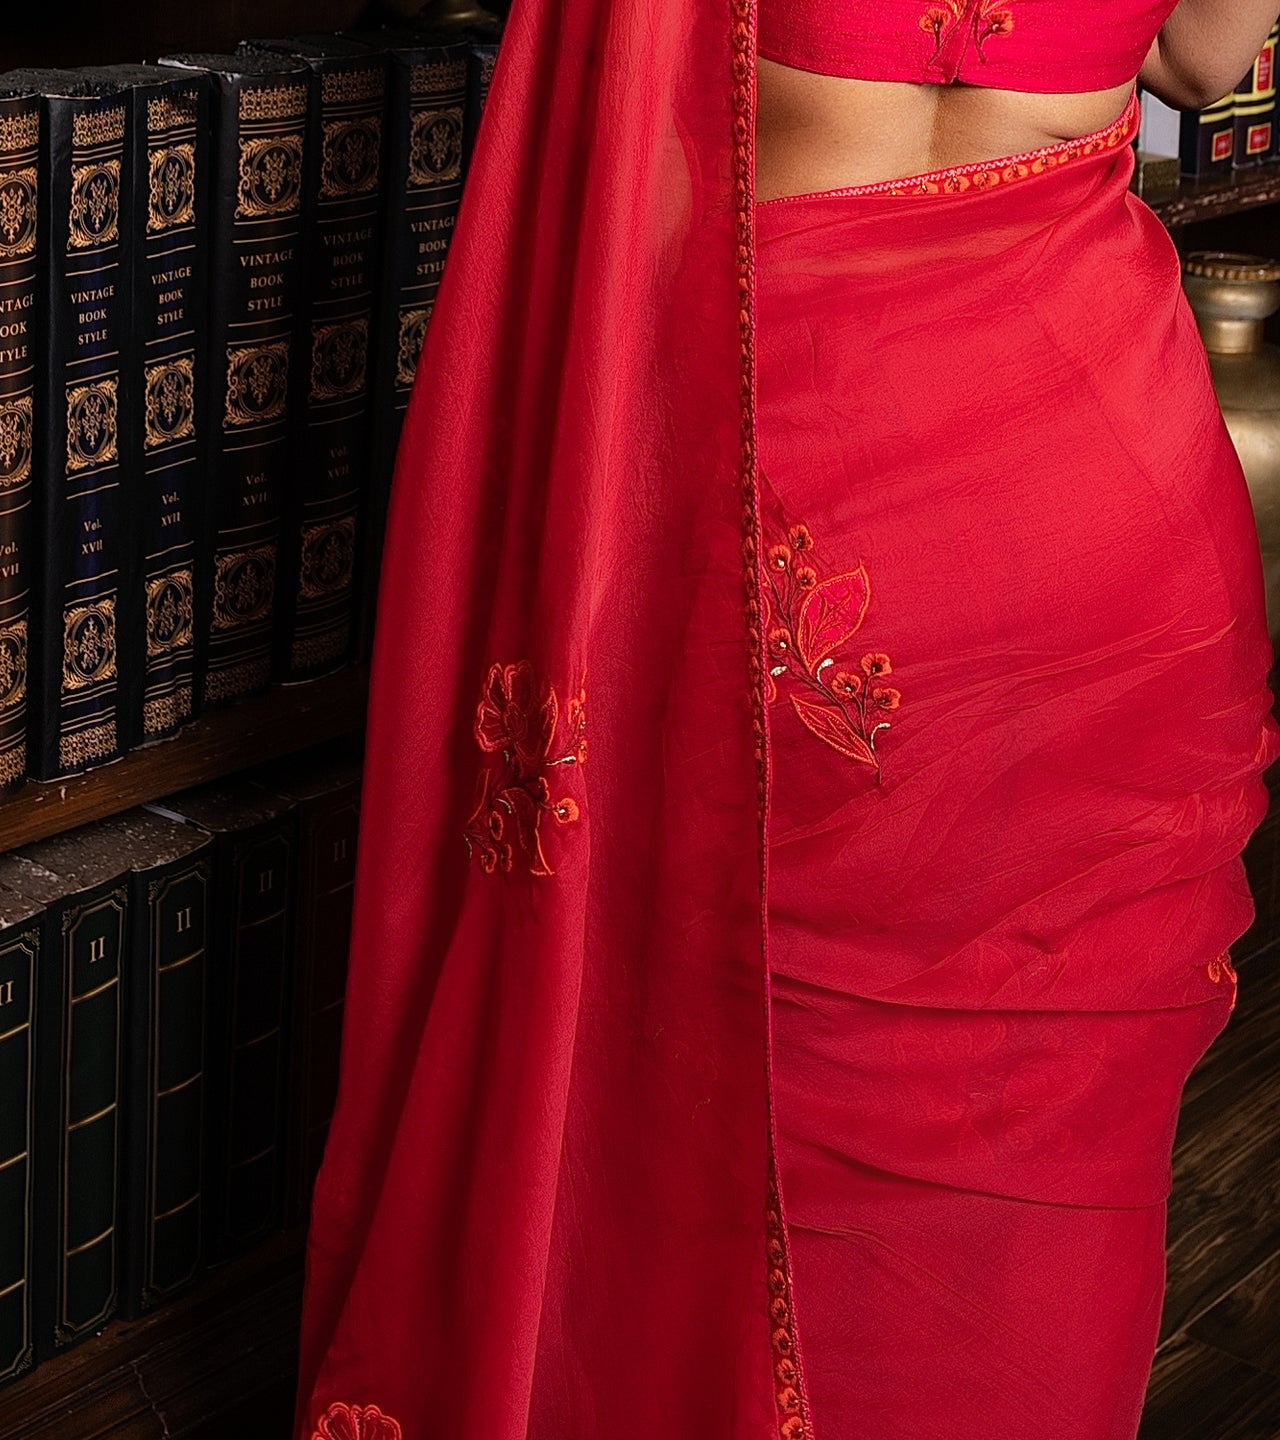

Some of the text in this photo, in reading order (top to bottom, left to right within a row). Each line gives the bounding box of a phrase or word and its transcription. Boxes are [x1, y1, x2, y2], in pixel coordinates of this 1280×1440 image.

[323, 227, 372, 246] VINTAGE
[418, 239, 448, 254] BOOK
[239, 249, 294, 267] VINTAGE
[333, 252, 363, 267] BOOK
[151, 266, 192, 285] VINTAGE
[250, 273, 284, 288] BOOK
[330, 273, 363, 289] STYLE
[70, 285, 114, 304] VINTAGE
[159, 288, 183, 305] BOOK
[247, 295, 283, 311] STYLE
[79, 308, 107, 324] BOOK
[157, 308, 183, 325] STYLE
[78, 329, 107, 346] STYLE
[245, 472, 267, 486] Vol.
[161, 491, 180, 505] Vol.
[242, 491, 267, 506] XVII
[83, 518, 102, 532] Vol.
[161, 511, 181, 526] XVII
[81, 539, 103, 555] XVII
[257, 869, 273, 894] II
[176, 906, 192, 933] II
[89, 936, 105, 963] II
